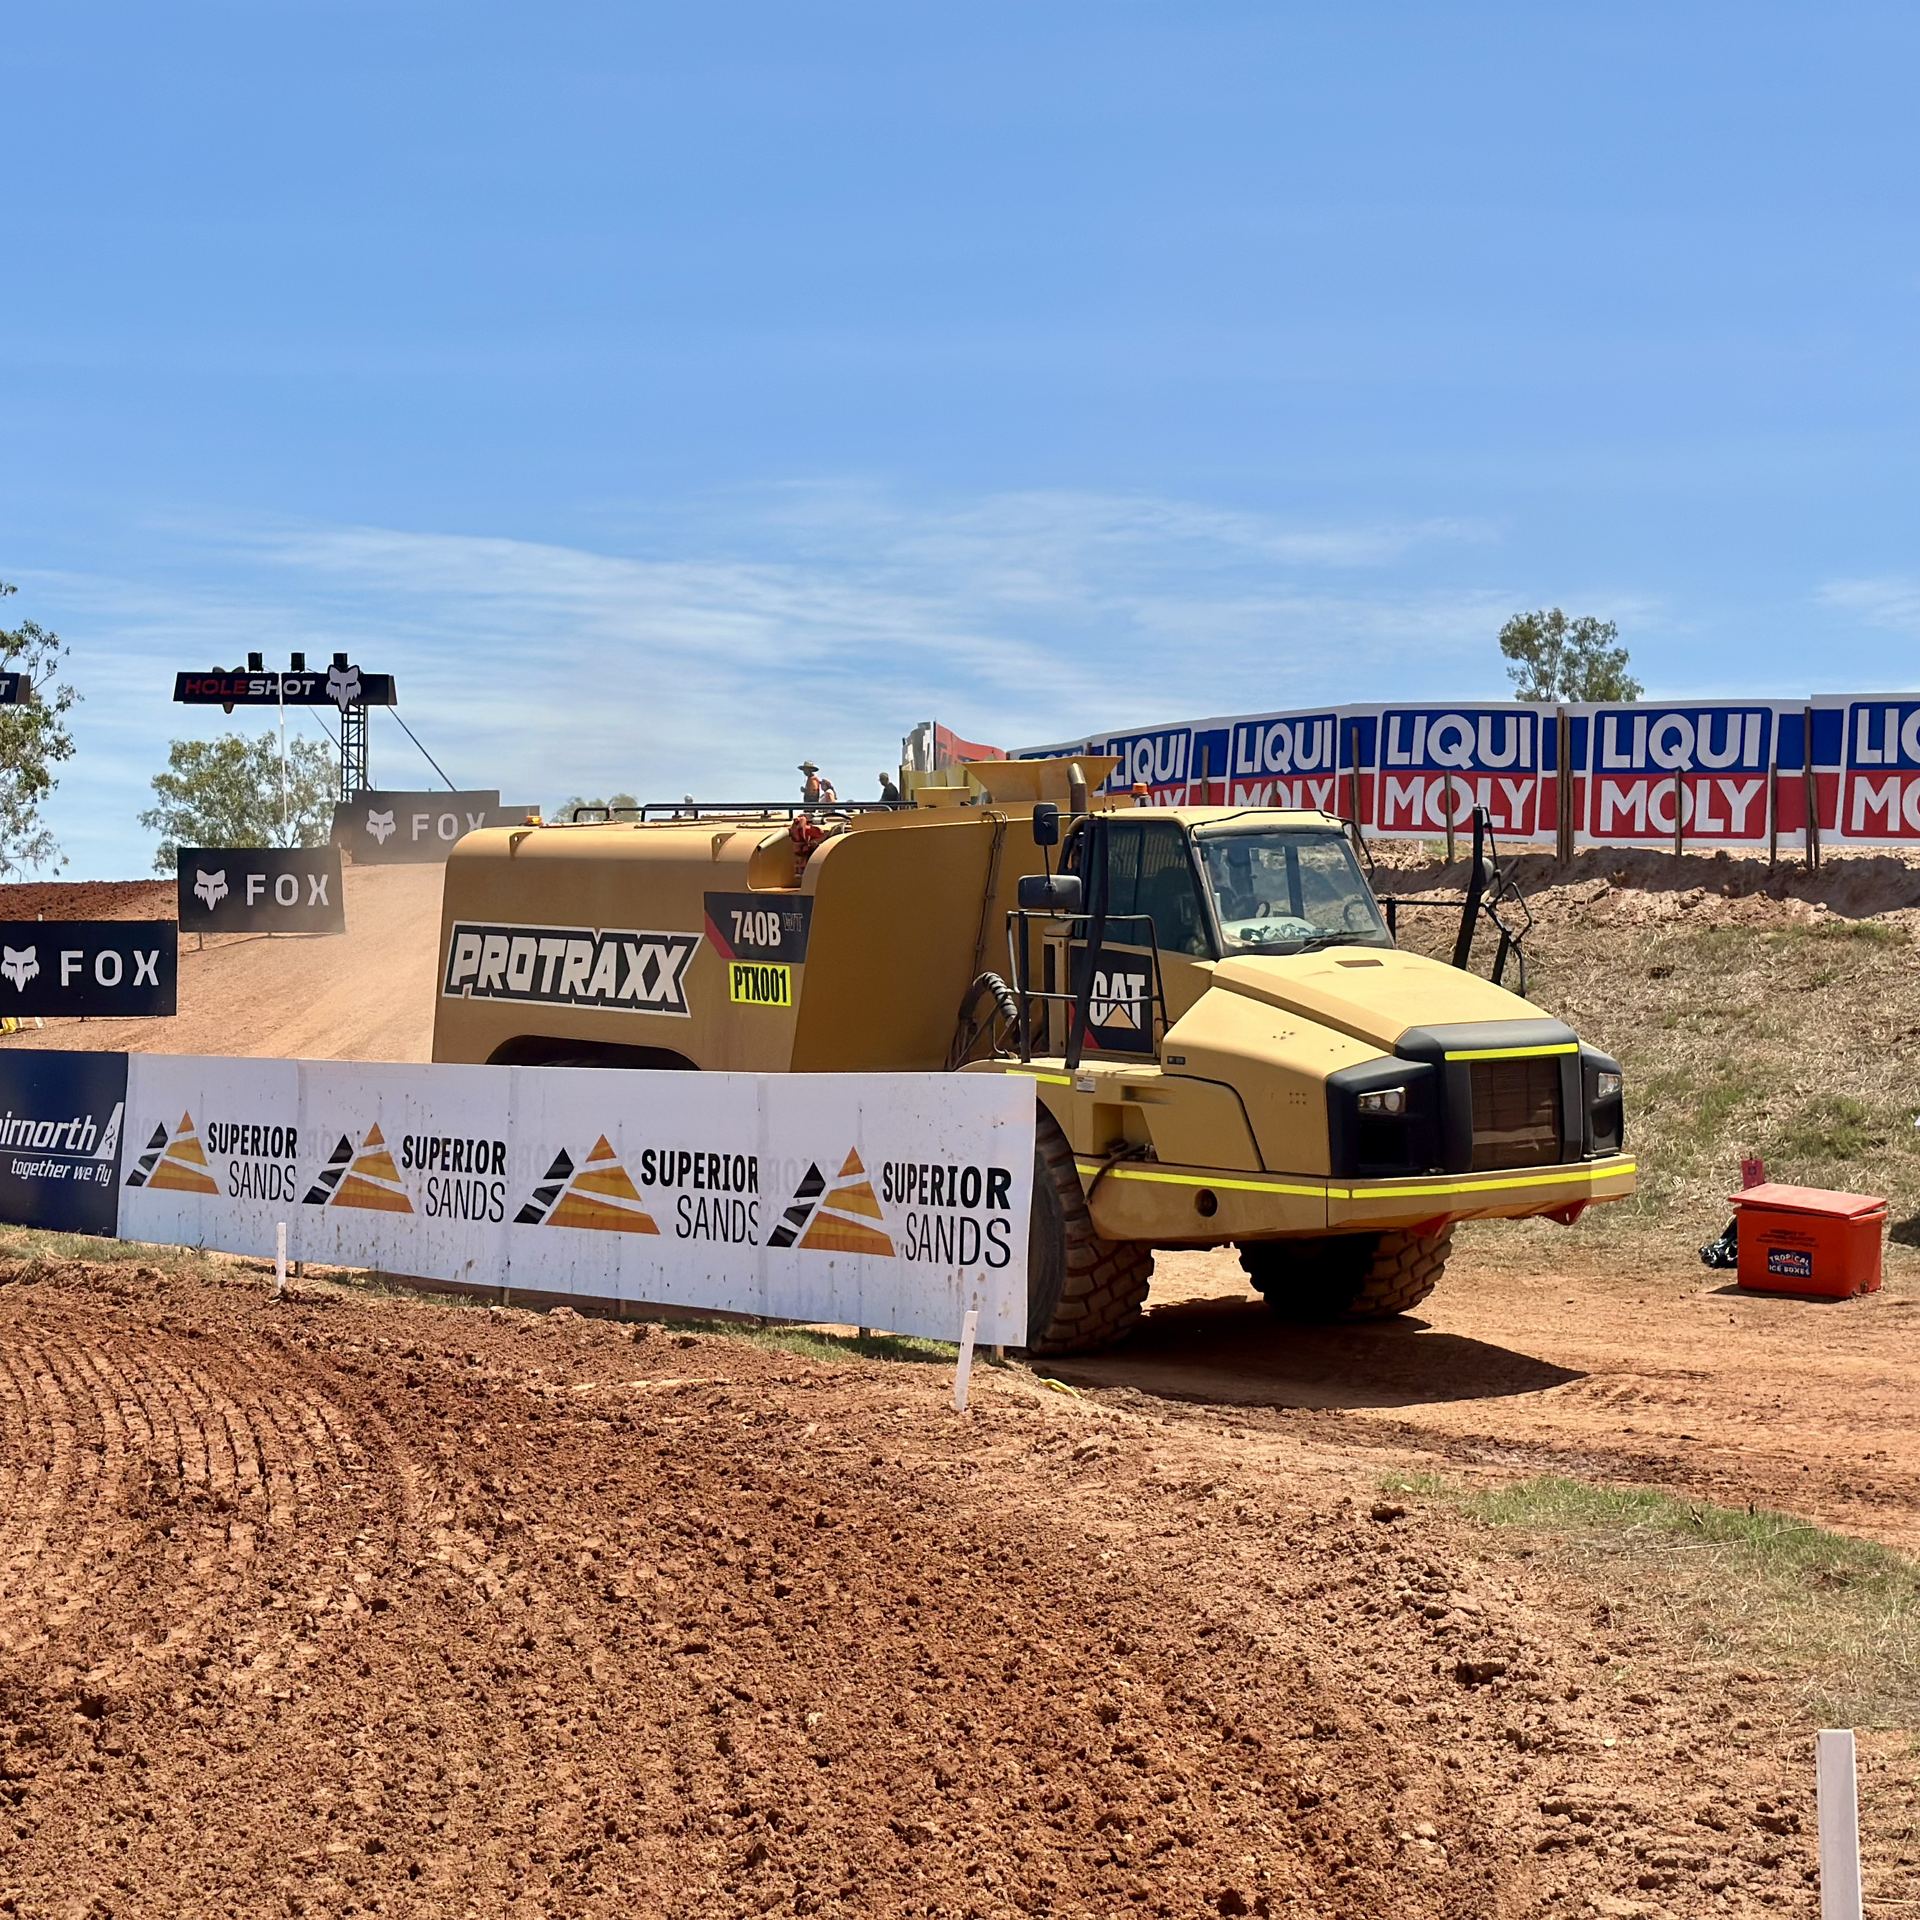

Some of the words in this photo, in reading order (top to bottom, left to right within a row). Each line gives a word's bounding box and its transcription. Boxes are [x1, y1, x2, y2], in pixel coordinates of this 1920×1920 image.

[184, 679, 316, 696] HOLESHOT
[1110, 733, 1187, 786] LIQUI
[1235, 720, 1333, 774] LIQUI
[1387, 714, 1532, 770] LIQUI
[1602, 713, 1760, 772] LIQUI
[1384, 776, 1535, 829] MOLY
[1599, 779, 1765, 833] MOLY
[246, 873, 329, 906] FOX
[730, 910, 782, 947] 740B
[60, 949, 160, 986] FOX
[451, 933, 687, 1003] PROTRAXX
[733, 965, 788, 1004] PTX001
[1089, 970, 1146, 1030] CAT
[207, 1121, 297, 1160] SUPERIOR
[401, 1134, 507, 1176] SUPERIOR
[11, 1158, 71, 1181] together
[73, 1165, 93, 1181] we
[95, 1163, 113, 1188] fly
[228, 1160, 297, 1203] SANDS
[641, 1149, 758, 1194] SUPERIOR
[882, 1160, 1012, 1211] SUPERIOR
[425, 1175, 506, 1224] SANDS
[675, 1194, 760, 1247] SANDS
[905, 1212, 1012, 1269] SANDS
[1769, 1254, 1809, 1266] TROPICAL
[1784, 1266, 1809, 1275] BOXES
